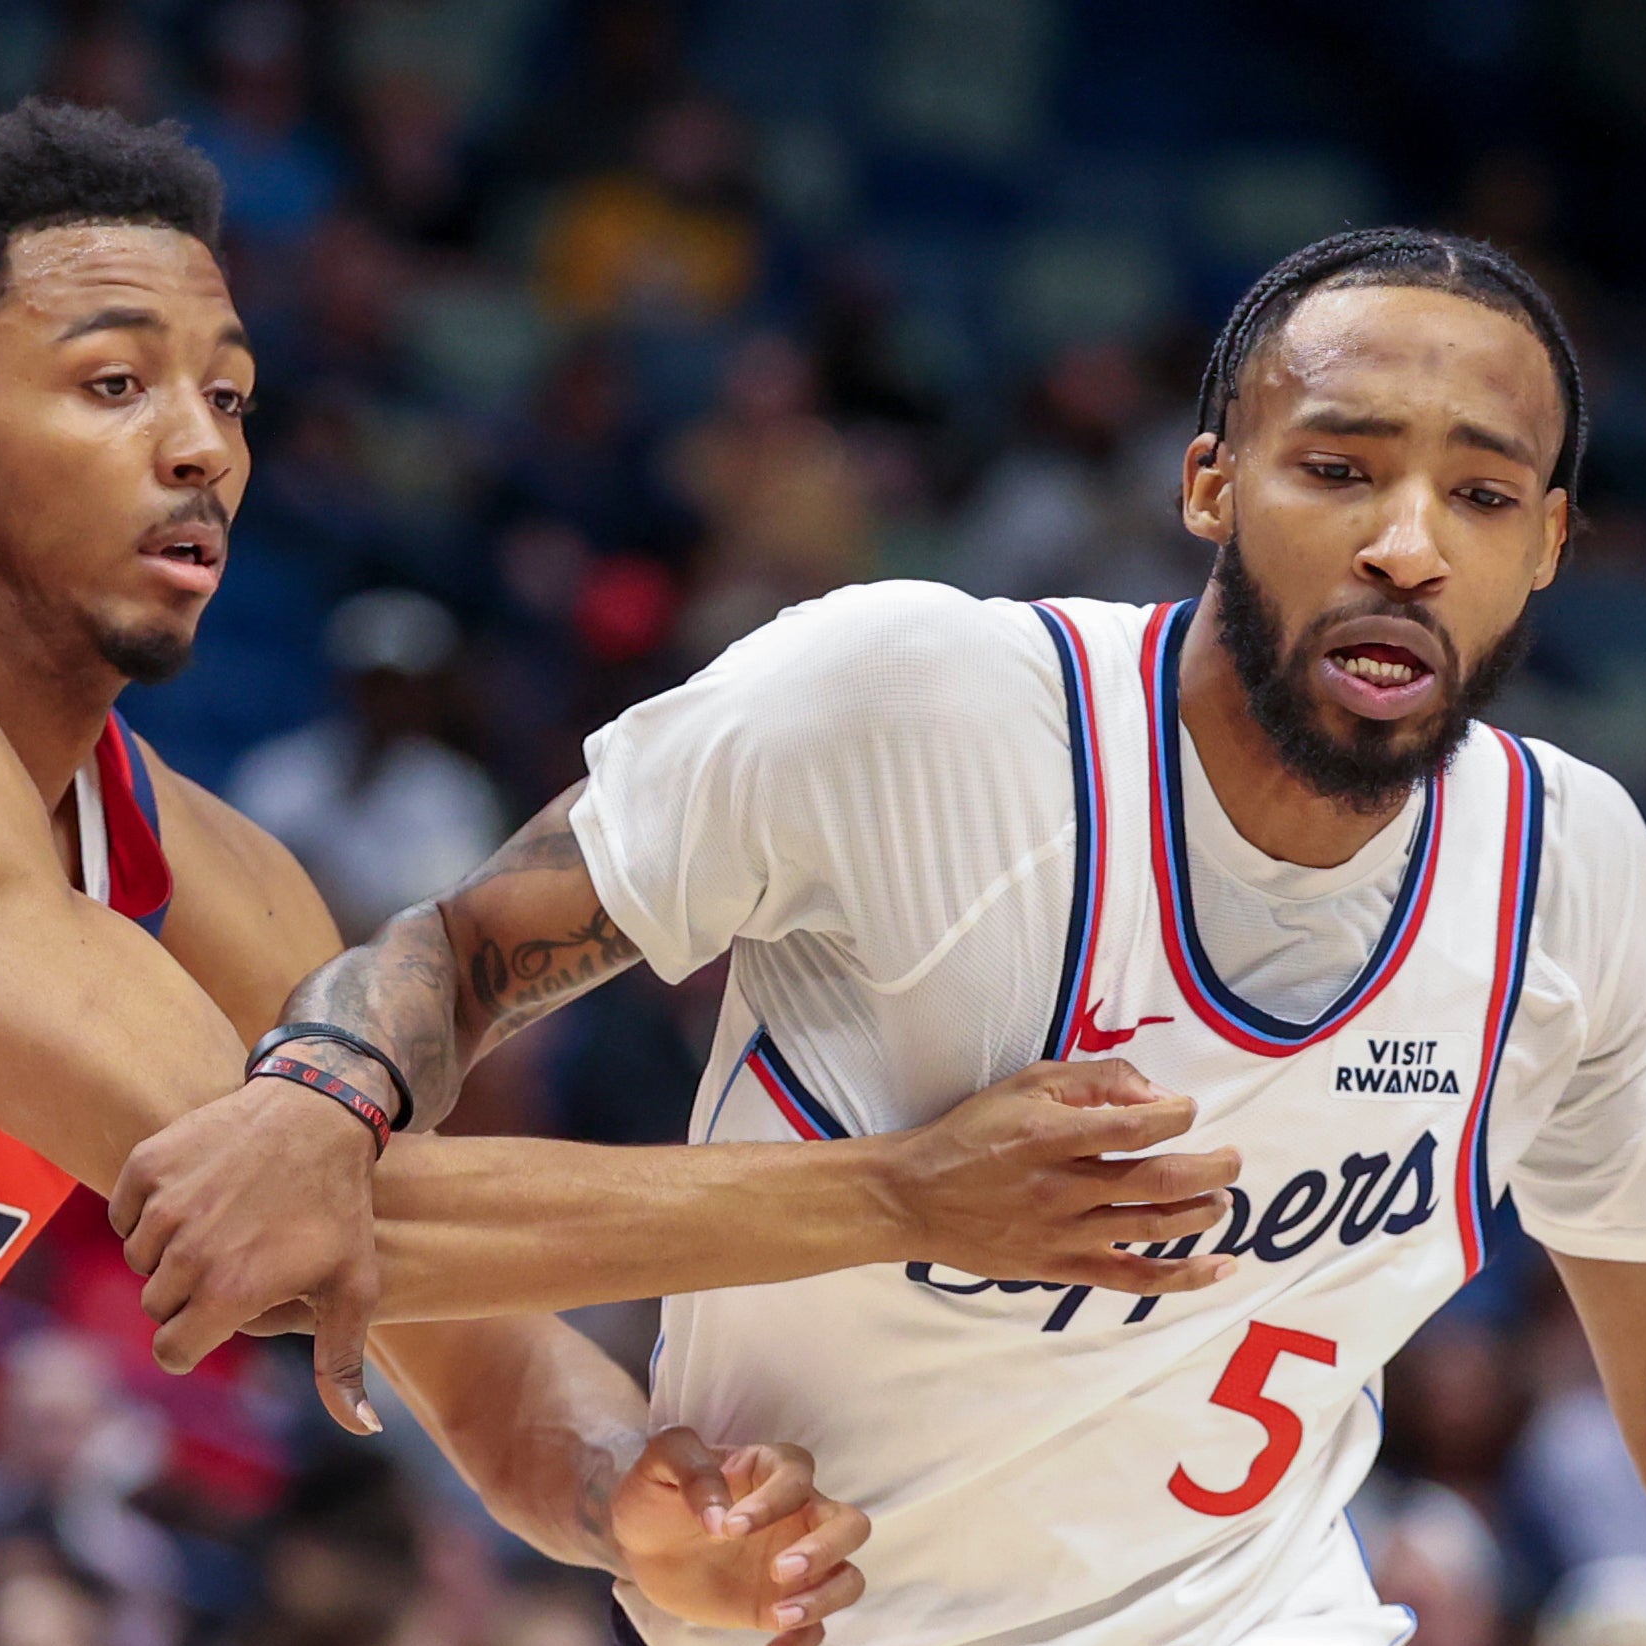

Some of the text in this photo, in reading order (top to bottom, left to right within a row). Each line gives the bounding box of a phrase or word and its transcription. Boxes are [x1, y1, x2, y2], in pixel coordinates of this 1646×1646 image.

[1367, 1038, 1438, 1066] VISIT
[1334, 1066, 1461, 1095] RWANDA
[1167, 1319, 1338, 1517] 5
